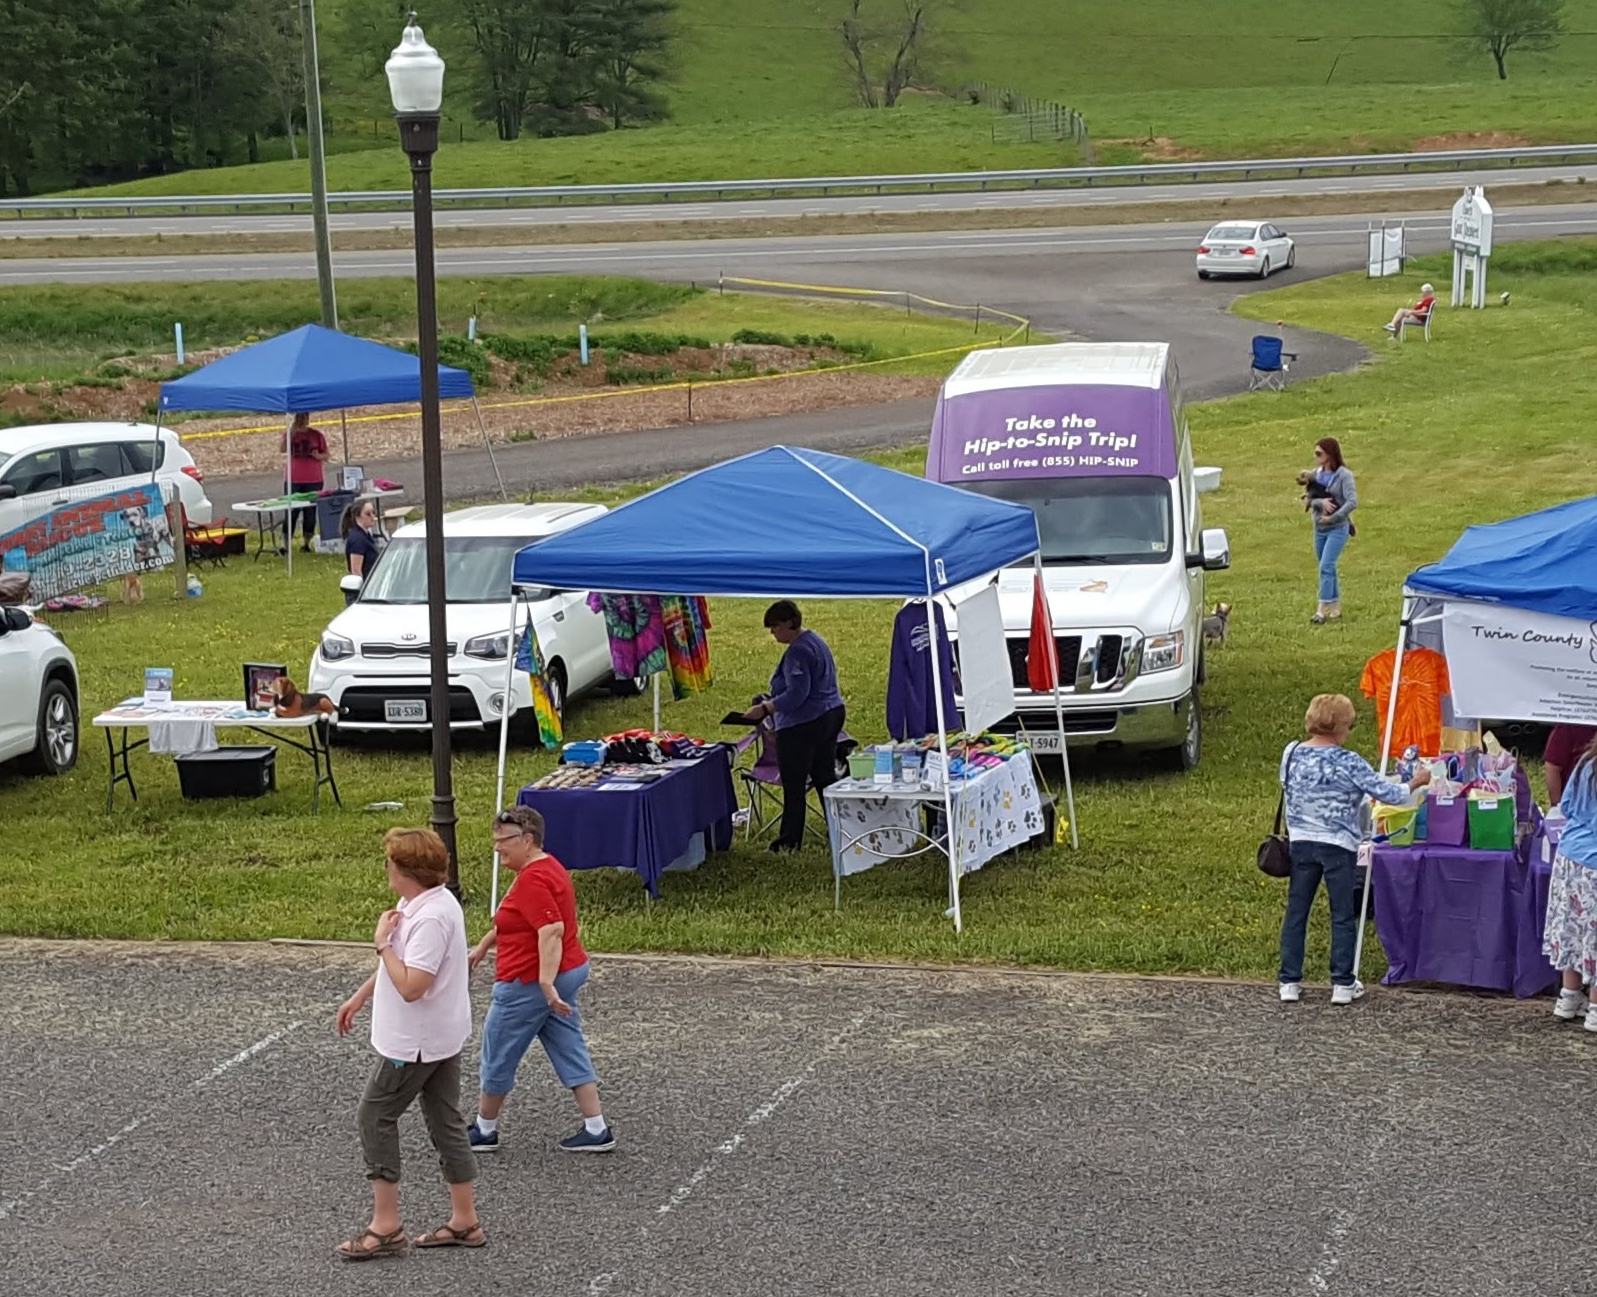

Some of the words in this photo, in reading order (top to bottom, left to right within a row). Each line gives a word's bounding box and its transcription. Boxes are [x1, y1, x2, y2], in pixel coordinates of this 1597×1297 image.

[1005, 415, 1056, 431] Take
[1061, 413, 1097, 428] the
[963, 432, 1083, 456] Hip-to-Snip
[1088, 431, 1137, 451] Trip!
[962, 462, 985, 474] Call
[989, 459, 1009, 470] toll
[1013, 457, 1038, 468] free
[1042, 456, 1075, 468] (855)
[1079, 456, 1139, 468] HIP-SNIP
[1471, 625, 1519, 641] Twin
[1522, 629, 1583, 649] County
